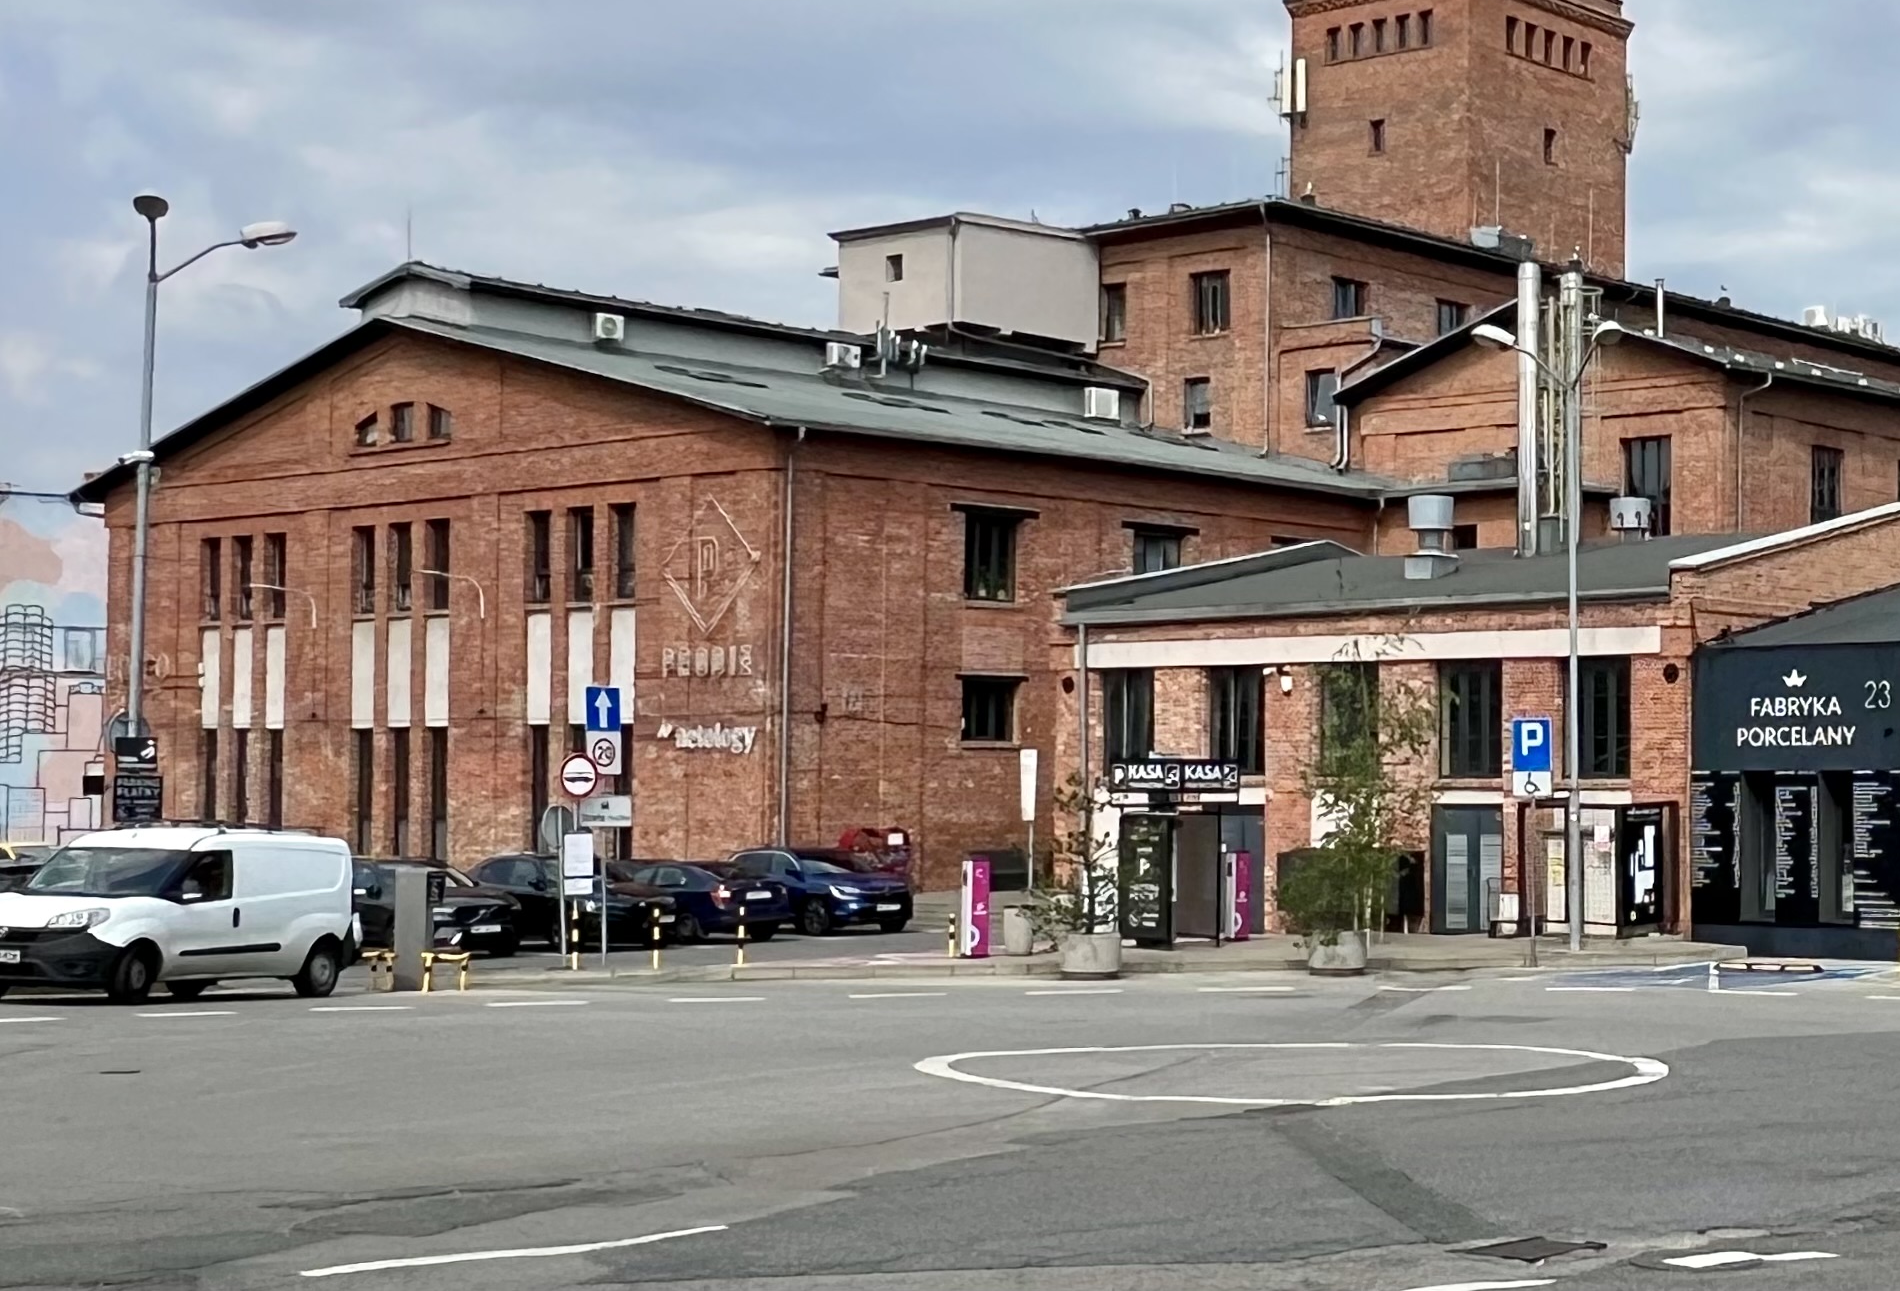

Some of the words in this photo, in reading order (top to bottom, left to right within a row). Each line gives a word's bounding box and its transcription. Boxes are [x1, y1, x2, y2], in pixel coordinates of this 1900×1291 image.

[1864, 680, 1892, 709] 23
[1750, 696, 1843, 717] FABRYKA
[1521, 722, 1544, 757] P
[1736, 725, 1857, 748] PORCELANY
[1128, 764, 1164, 780] KASA
[1184, 764, 1222, 780] KASA
